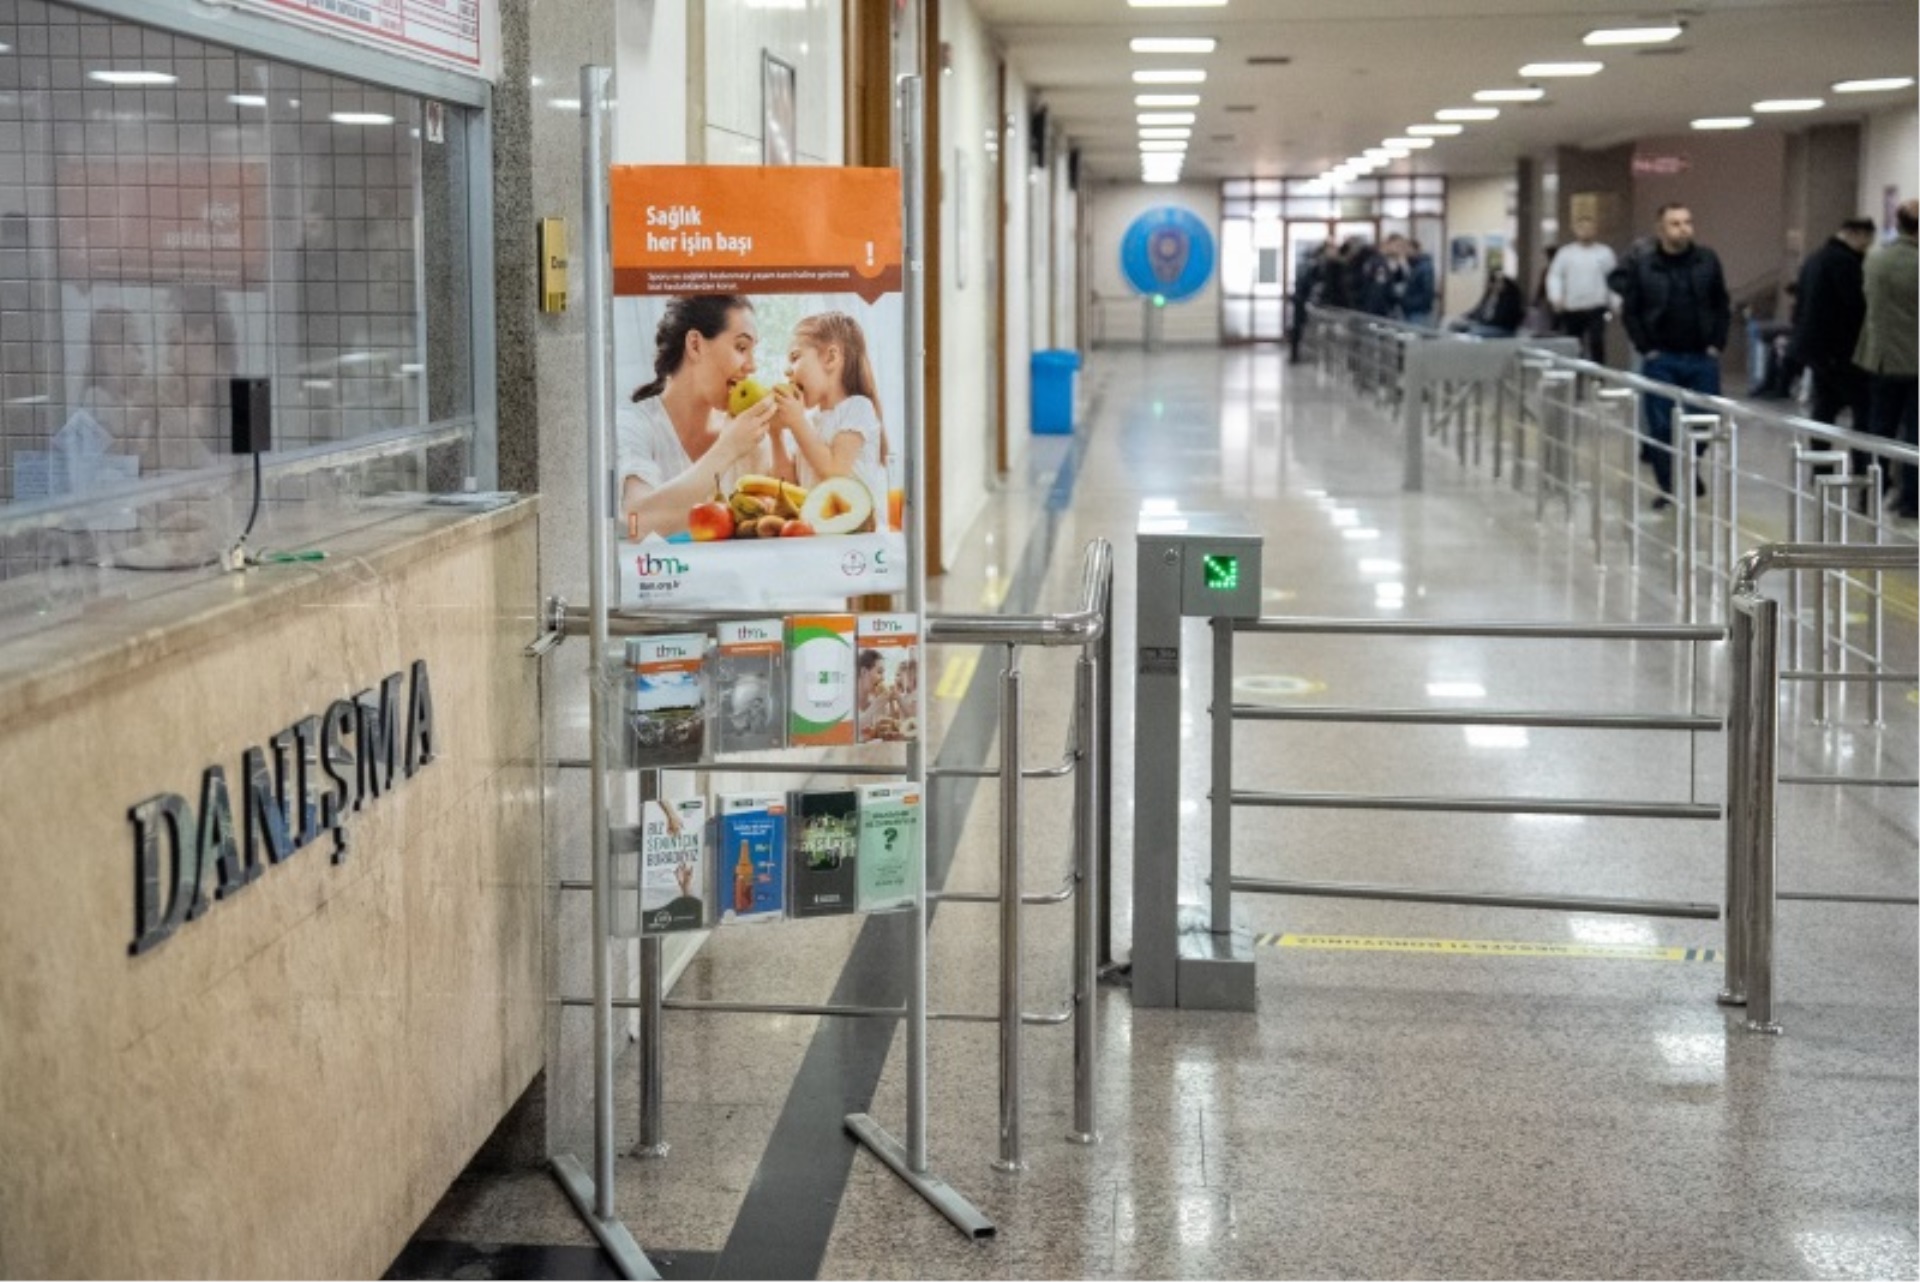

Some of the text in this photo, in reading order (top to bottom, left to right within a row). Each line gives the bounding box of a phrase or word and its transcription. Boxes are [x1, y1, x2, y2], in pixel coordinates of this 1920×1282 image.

[646, 205, 702, 230] Sağlık
[646, 231, 752, 257] her işin başı
[866, 241, 875, 267] !
[127, 659, 434, 957] DANIŞMA
